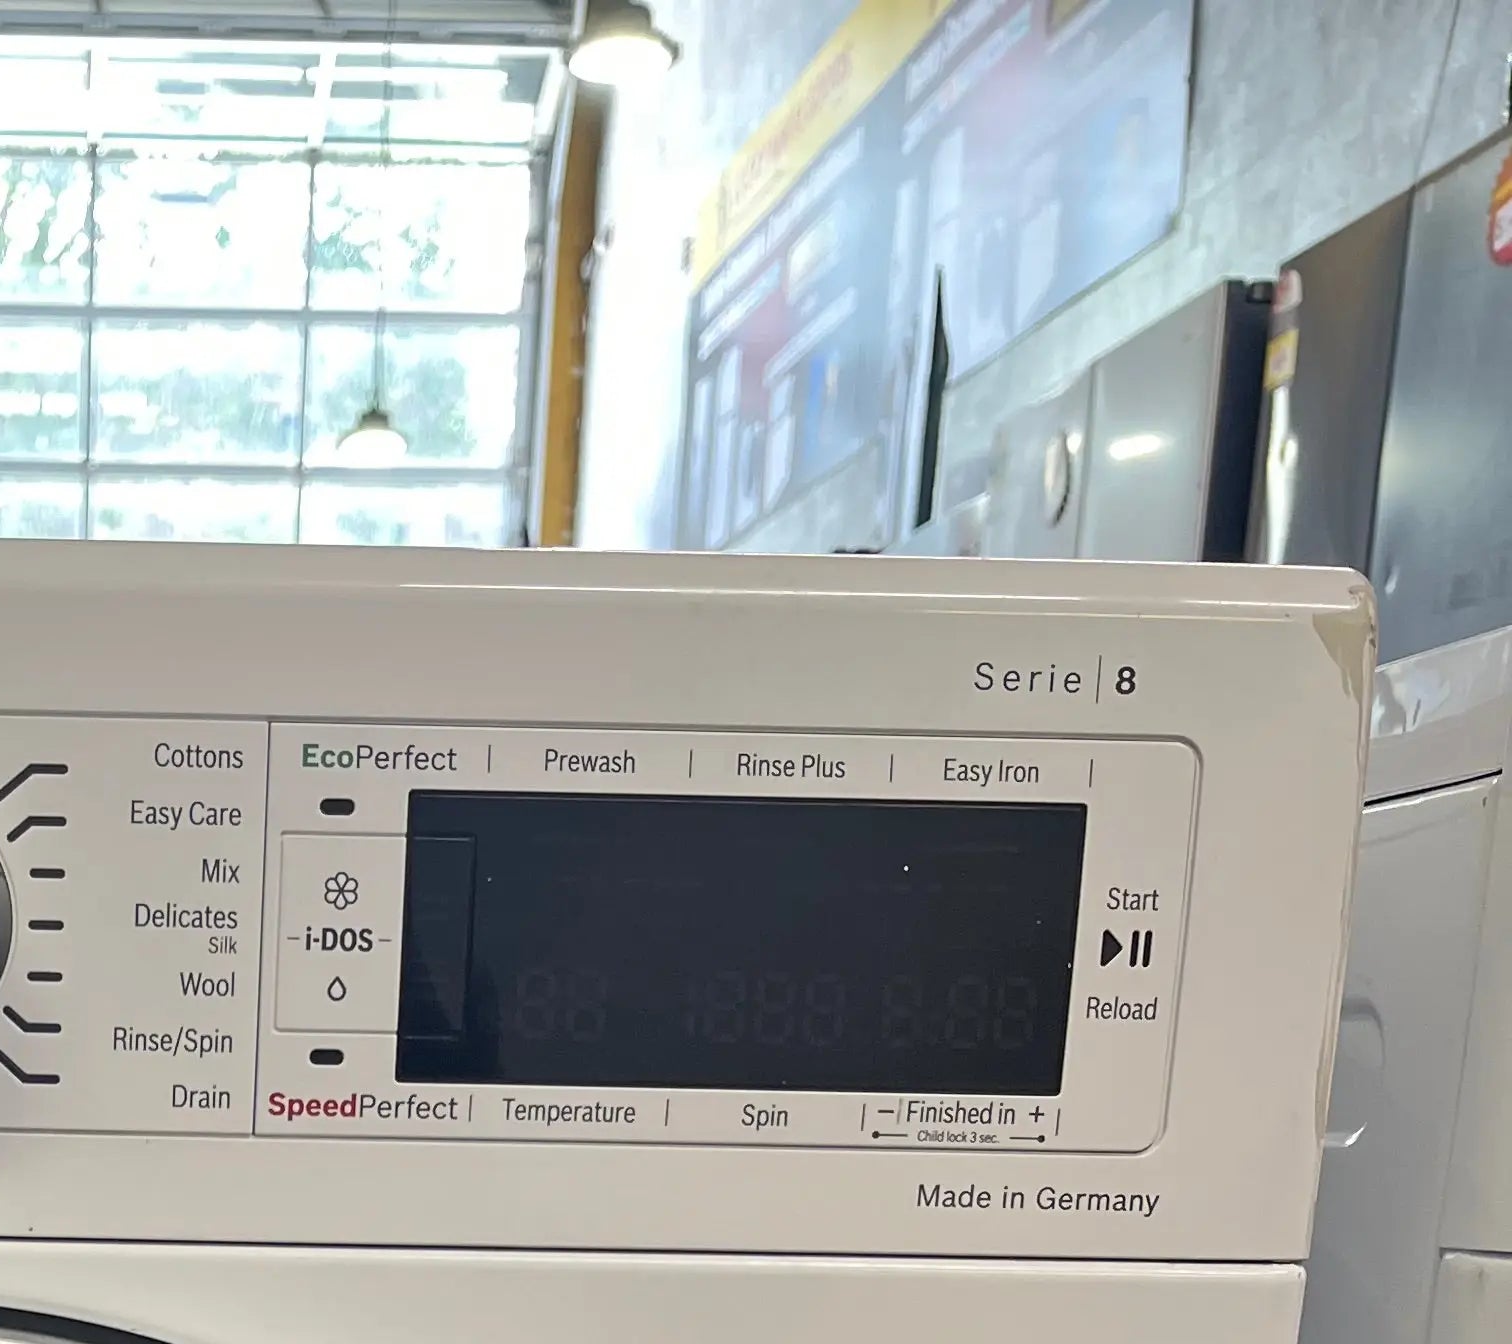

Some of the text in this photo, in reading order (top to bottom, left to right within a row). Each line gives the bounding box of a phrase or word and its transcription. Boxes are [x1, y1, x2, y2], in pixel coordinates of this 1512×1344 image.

[973, 661, 1137, 696] Serie 8
[154, 742, 244, 770] Cottons
[301, 743, 458, 772] EcoPerfect
[544, 748, 637, 775] Prewash
[736, 753, 846, 779] Rinse Plus
[942, 757, 1040, 788] Easy Iron
[129, 799, 242, 831] Easy Care
[200, 858, 241, 885] Mix
[1106, 886, 1160, 912] Start
[133, 902, 239, 930] Delicates
[207, 935, 238, 955] Silk
[304, 927, 374, 953] i-DOS
[179, 971, 236, 998] Wool
[1085, 996, 1158, 1021] Reload
[112, 1025, 234, 1058] Rinse/Spin
[171, 1084, 232, 1110] Drain
[267, 1092, 459, 1122] SpeedPerfect
[501, 1097, 637, 1128] Temperature
[740, 1103, 789, 1133] Spin
[906, 1099, 1017, 1126] Finished in
[916, 1129, 945, 1144] Child
[946, 1130, 968, 1144] lock
[969, 1131, 978, 1144] 3
[915, 1184, 1161, 1218] Made in Germany
